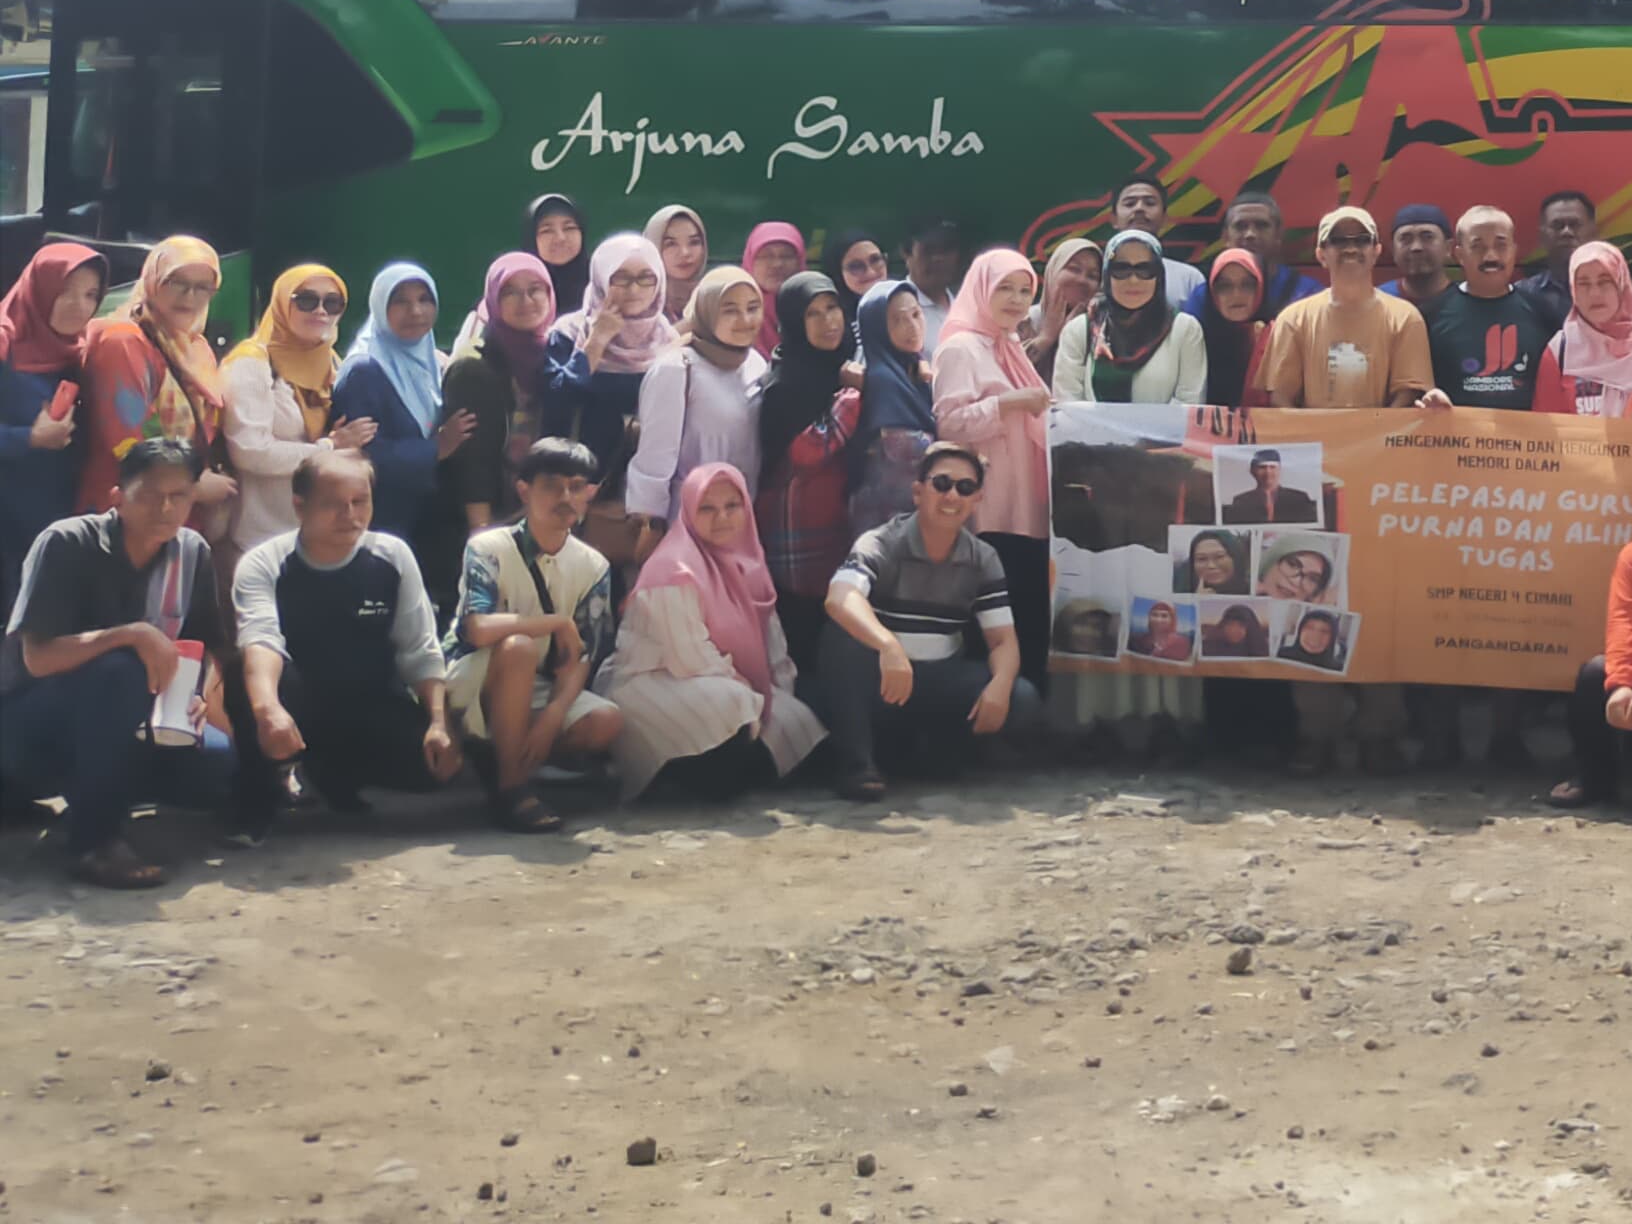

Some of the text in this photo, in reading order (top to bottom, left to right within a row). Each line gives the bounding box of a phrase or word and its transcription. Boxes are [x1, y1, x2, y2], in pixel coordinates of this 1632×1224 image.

[531, 91, 984, 194] Arjuna Samba
[1385, 435, 1470, 449] MENGENANG
[1476, 437, 1522, 452] MOMEN
[1527, 440, 1554, 454] DAN
[1457, 455, 1560, 472] MEMORI DALAM
[1371, 482, 1546, 512] PELEPASAN
[1378, 514, 1632, 545] PURNA DAN ALIH
[1459, 545, 1554, 572] TUGAS
[1427, 587, 1455, 600] SMP
[1459, 588, 1507, 602] NEGERI
[1525, 592, 1573, 607] CIMAHI
[1434, 636, 1568, 655] PANGANDARAN
